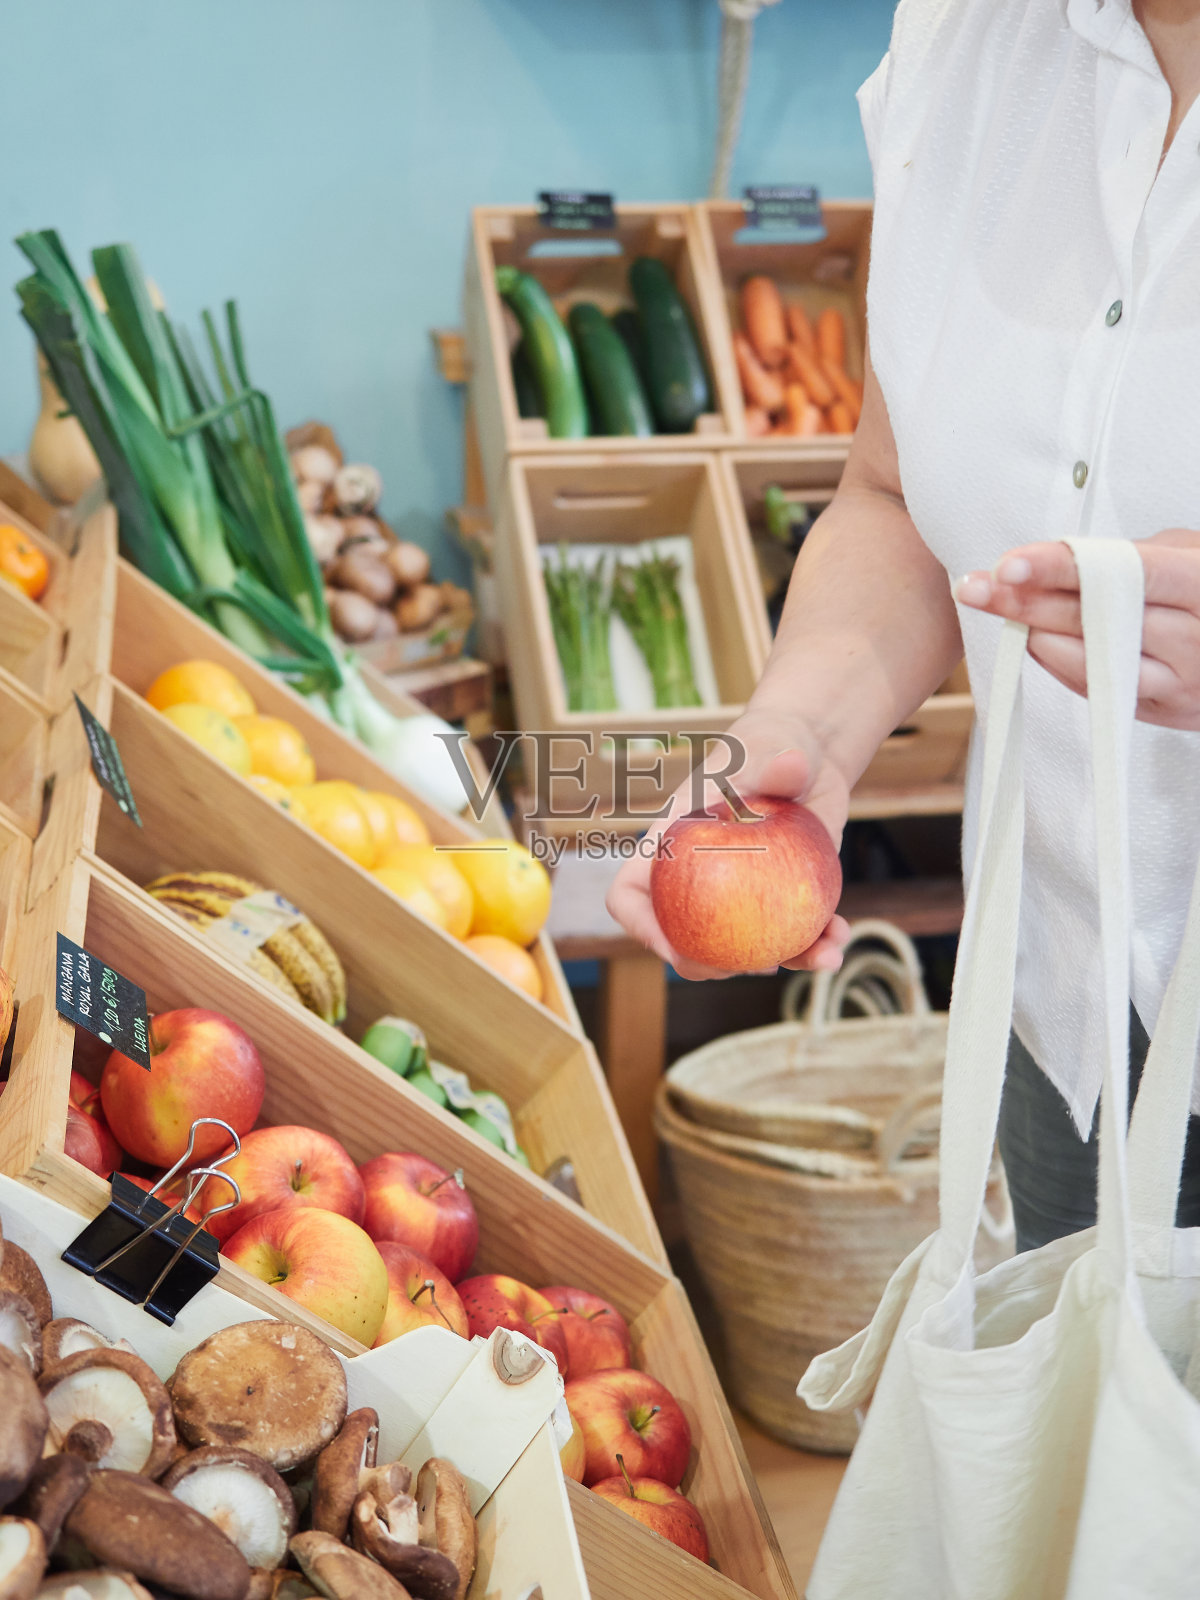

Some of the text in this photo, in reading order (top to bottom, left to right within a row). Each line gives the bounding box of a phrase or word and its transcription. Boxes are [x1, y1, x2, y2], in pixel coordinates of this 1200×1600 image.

[61, 952, 74, 1006] MANZANA
[77, 953, 92, 1018] ROYAL GALA
[134, 1017, 147, 1053] LLEIDA
